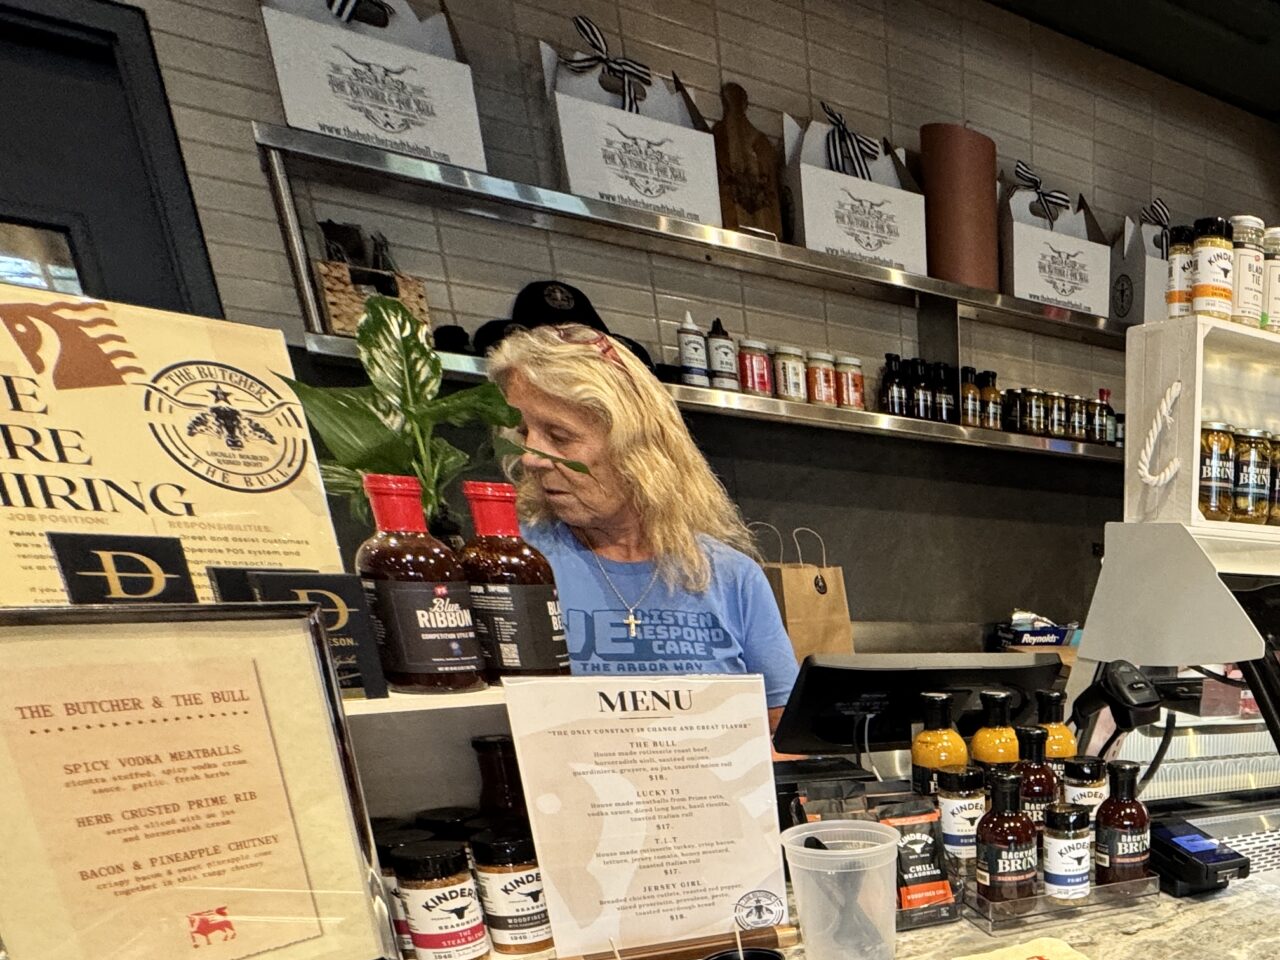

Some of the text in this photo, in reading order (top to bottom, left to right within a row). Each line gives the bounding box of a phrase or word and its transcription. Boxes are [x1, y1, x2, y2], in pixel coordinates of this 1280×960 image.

[166, 366, 268, 399] THE BUTCHER
[0, 375, 48, 415] E
[0, 424, 93, 465] RE
[191, 457, 289, 488] THE BULL
[429, 598, 462, 613] Blue
[416, 609, 473, 629] RIBBON
[636, 610, 713, 628] LISTEN
[652, 641, 708, 656] CARE
[581, 662, 704, 672] THE ARBOR WAY
[15, 689, 250, 720] THE BUTCHER & THE BULL
[597, 689, 694, 713] MENU
[653, 740, 678, 748] BULL
[63, 744, 243, 775] SPICY VODKA MEATBALLS
[636, 788, 667, 798] LUCKY
[75, 791, 258, 828] HERB CRUSTED PRIME RIB
[1117, 839, 1150, 855] BRIN
[79, 834, 280, 882] BACON & PINEAPPLE CHUTNEY
[997, 857, 1037, 873] BRIN
[909, 864, 935, 873] CHILI
[501, 872, 542, 895] KINDE
[643, 879, 703, 893] JERSEY GIRL
